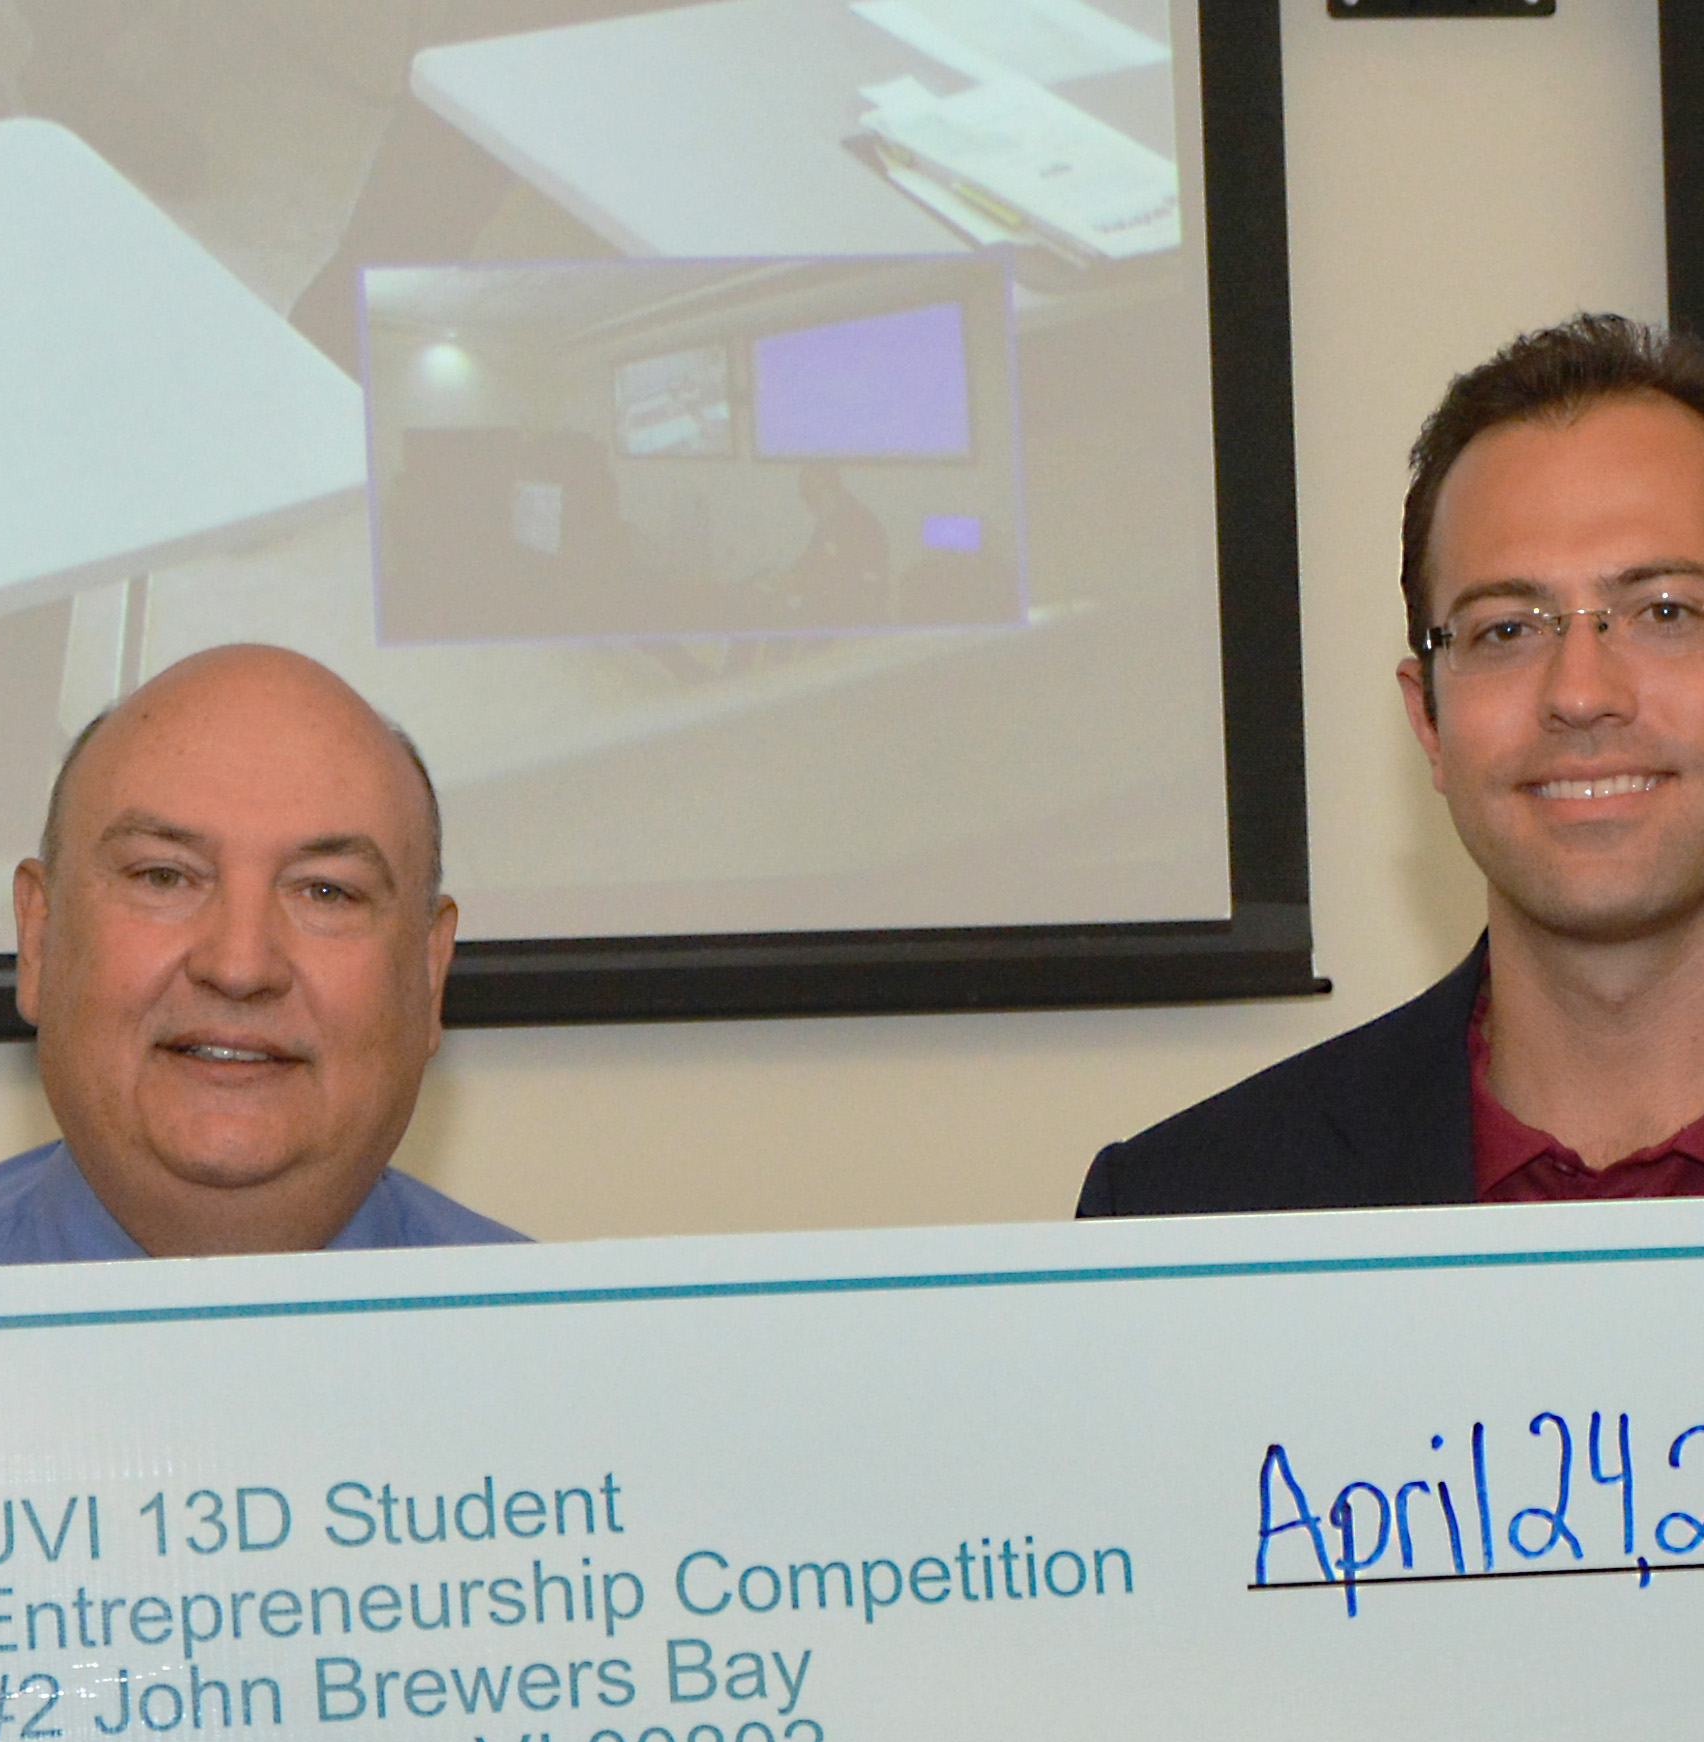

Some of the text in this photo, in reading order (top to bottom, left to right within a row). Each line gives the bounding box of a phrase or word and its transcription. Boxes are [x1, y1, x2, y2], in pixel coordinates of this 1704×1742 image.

[141, 1486, 294, 1557] 13D
[325, 1472, 626, 1547] Student
[1255, 1420, 1494, 1618] April
[676, 1535, 1136, 1626] Competition
[94, 1665, 284, 1737] John
[316, 1646, 637, 1724] Brewers
[667, 1637, 815, 1716] Bay
